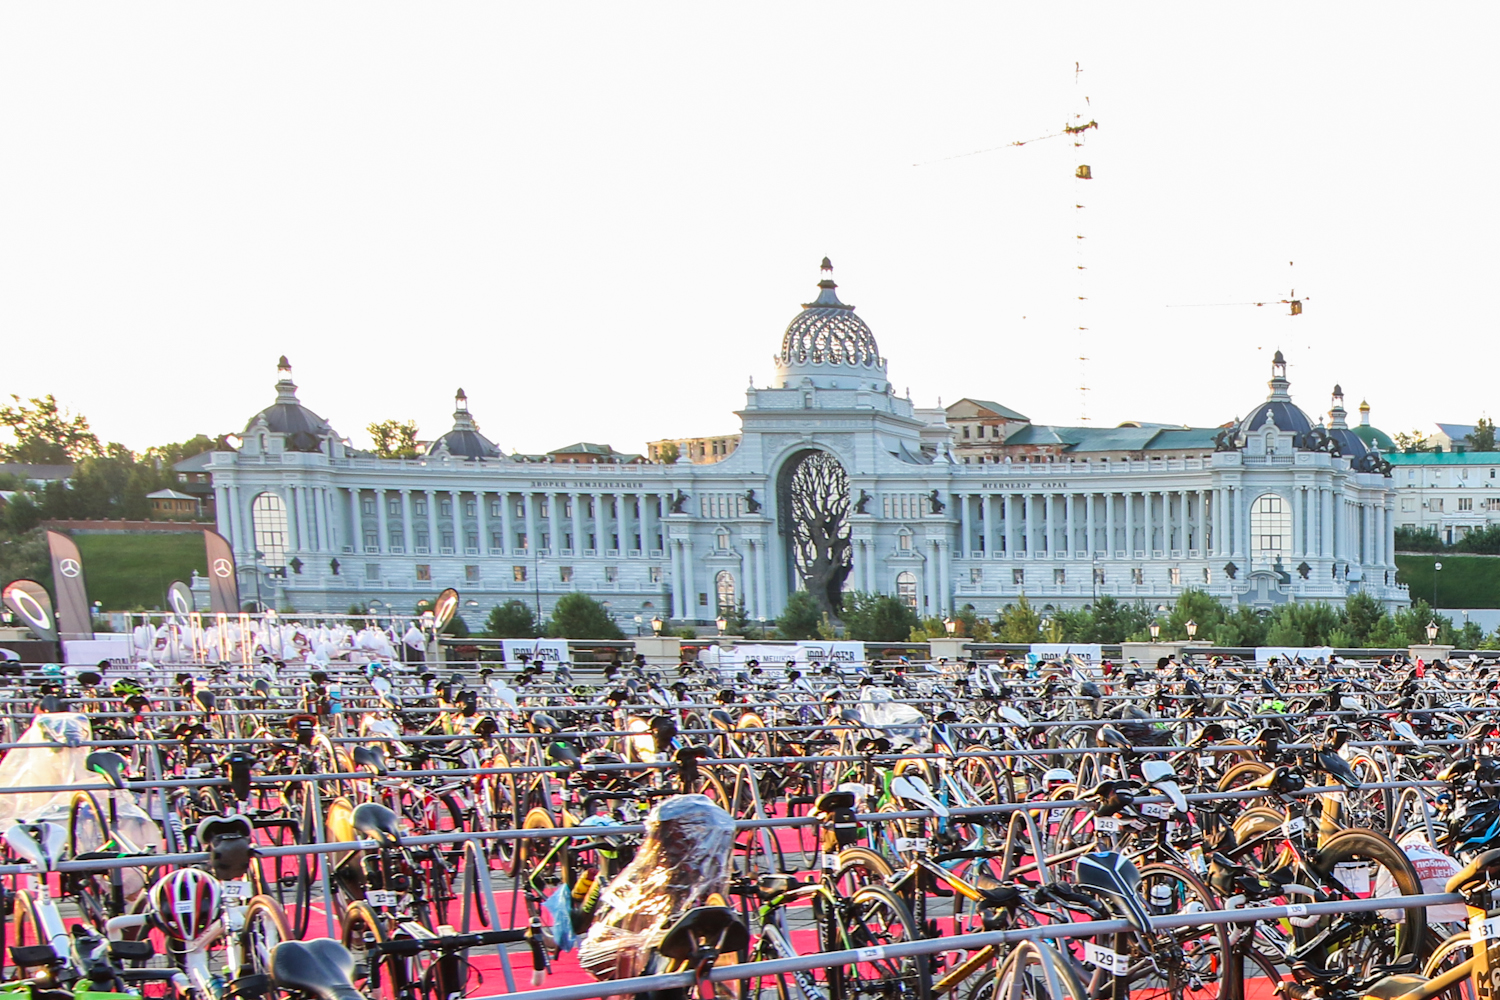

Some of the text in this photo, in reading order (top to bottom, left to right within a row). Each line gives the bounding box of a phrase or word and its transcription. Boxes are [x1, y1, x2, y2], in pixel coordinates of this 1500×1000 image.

[1100, 820, 1114, 829] 243
[1478, 923, 1494, 937] 131
[1094, 951, 1115, 967] 129
